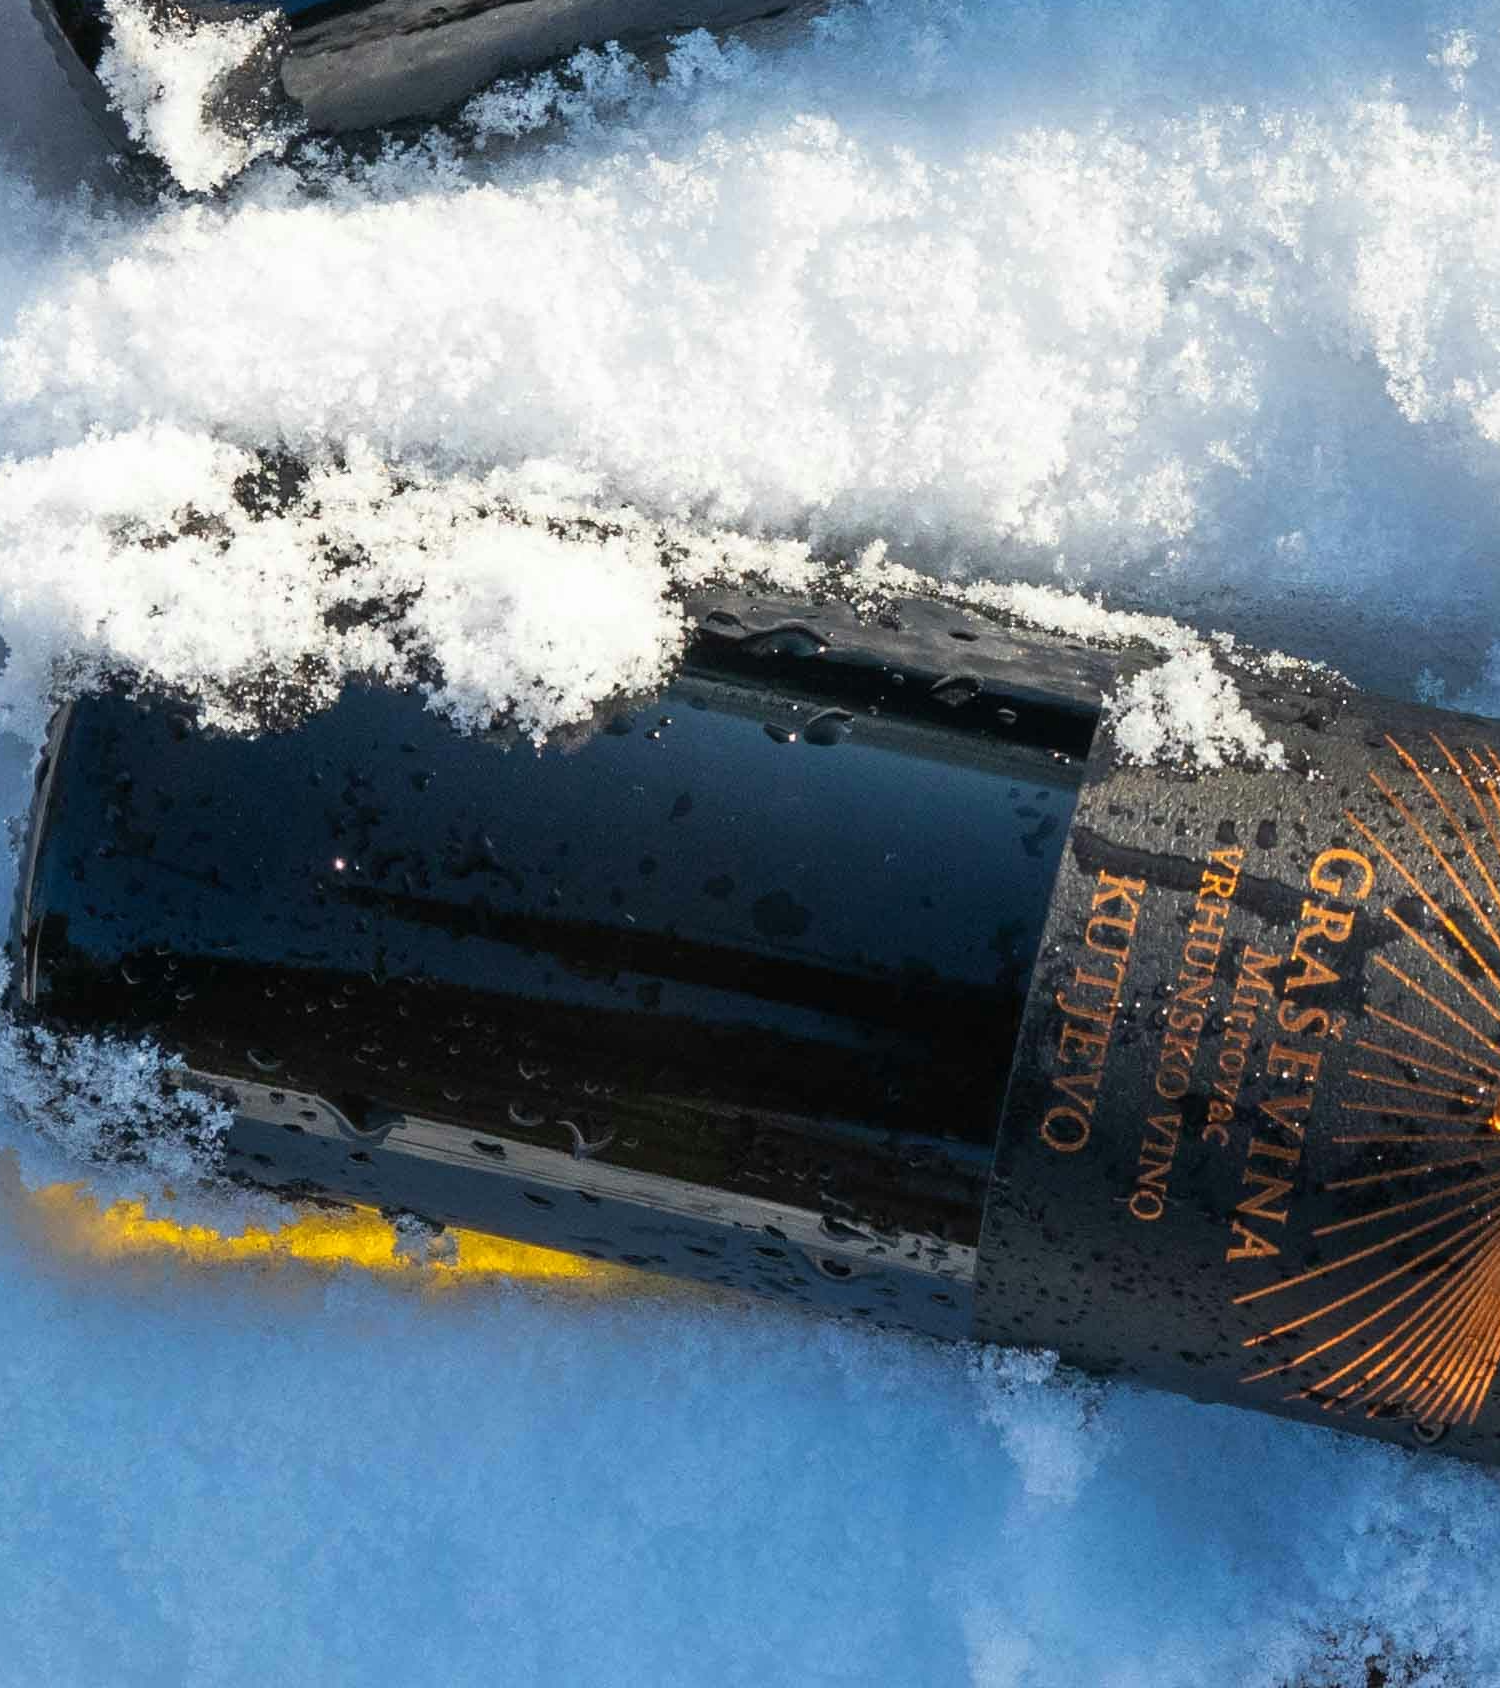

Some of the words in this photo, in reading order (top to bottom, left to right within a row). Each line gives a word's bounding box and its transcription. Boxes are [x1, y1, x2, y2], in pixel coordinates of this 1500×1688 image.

[1040, 868, 1148, 1153] KUTJEVO
[1155, 847, 1244, 1099] VRHUNSKO
[1201, 944, 1283, 1147] Mitrovac
[1225, 847, 1375, 1263] GRAŠEVINA
[1128, 1111, 1183, 1222] VINO
